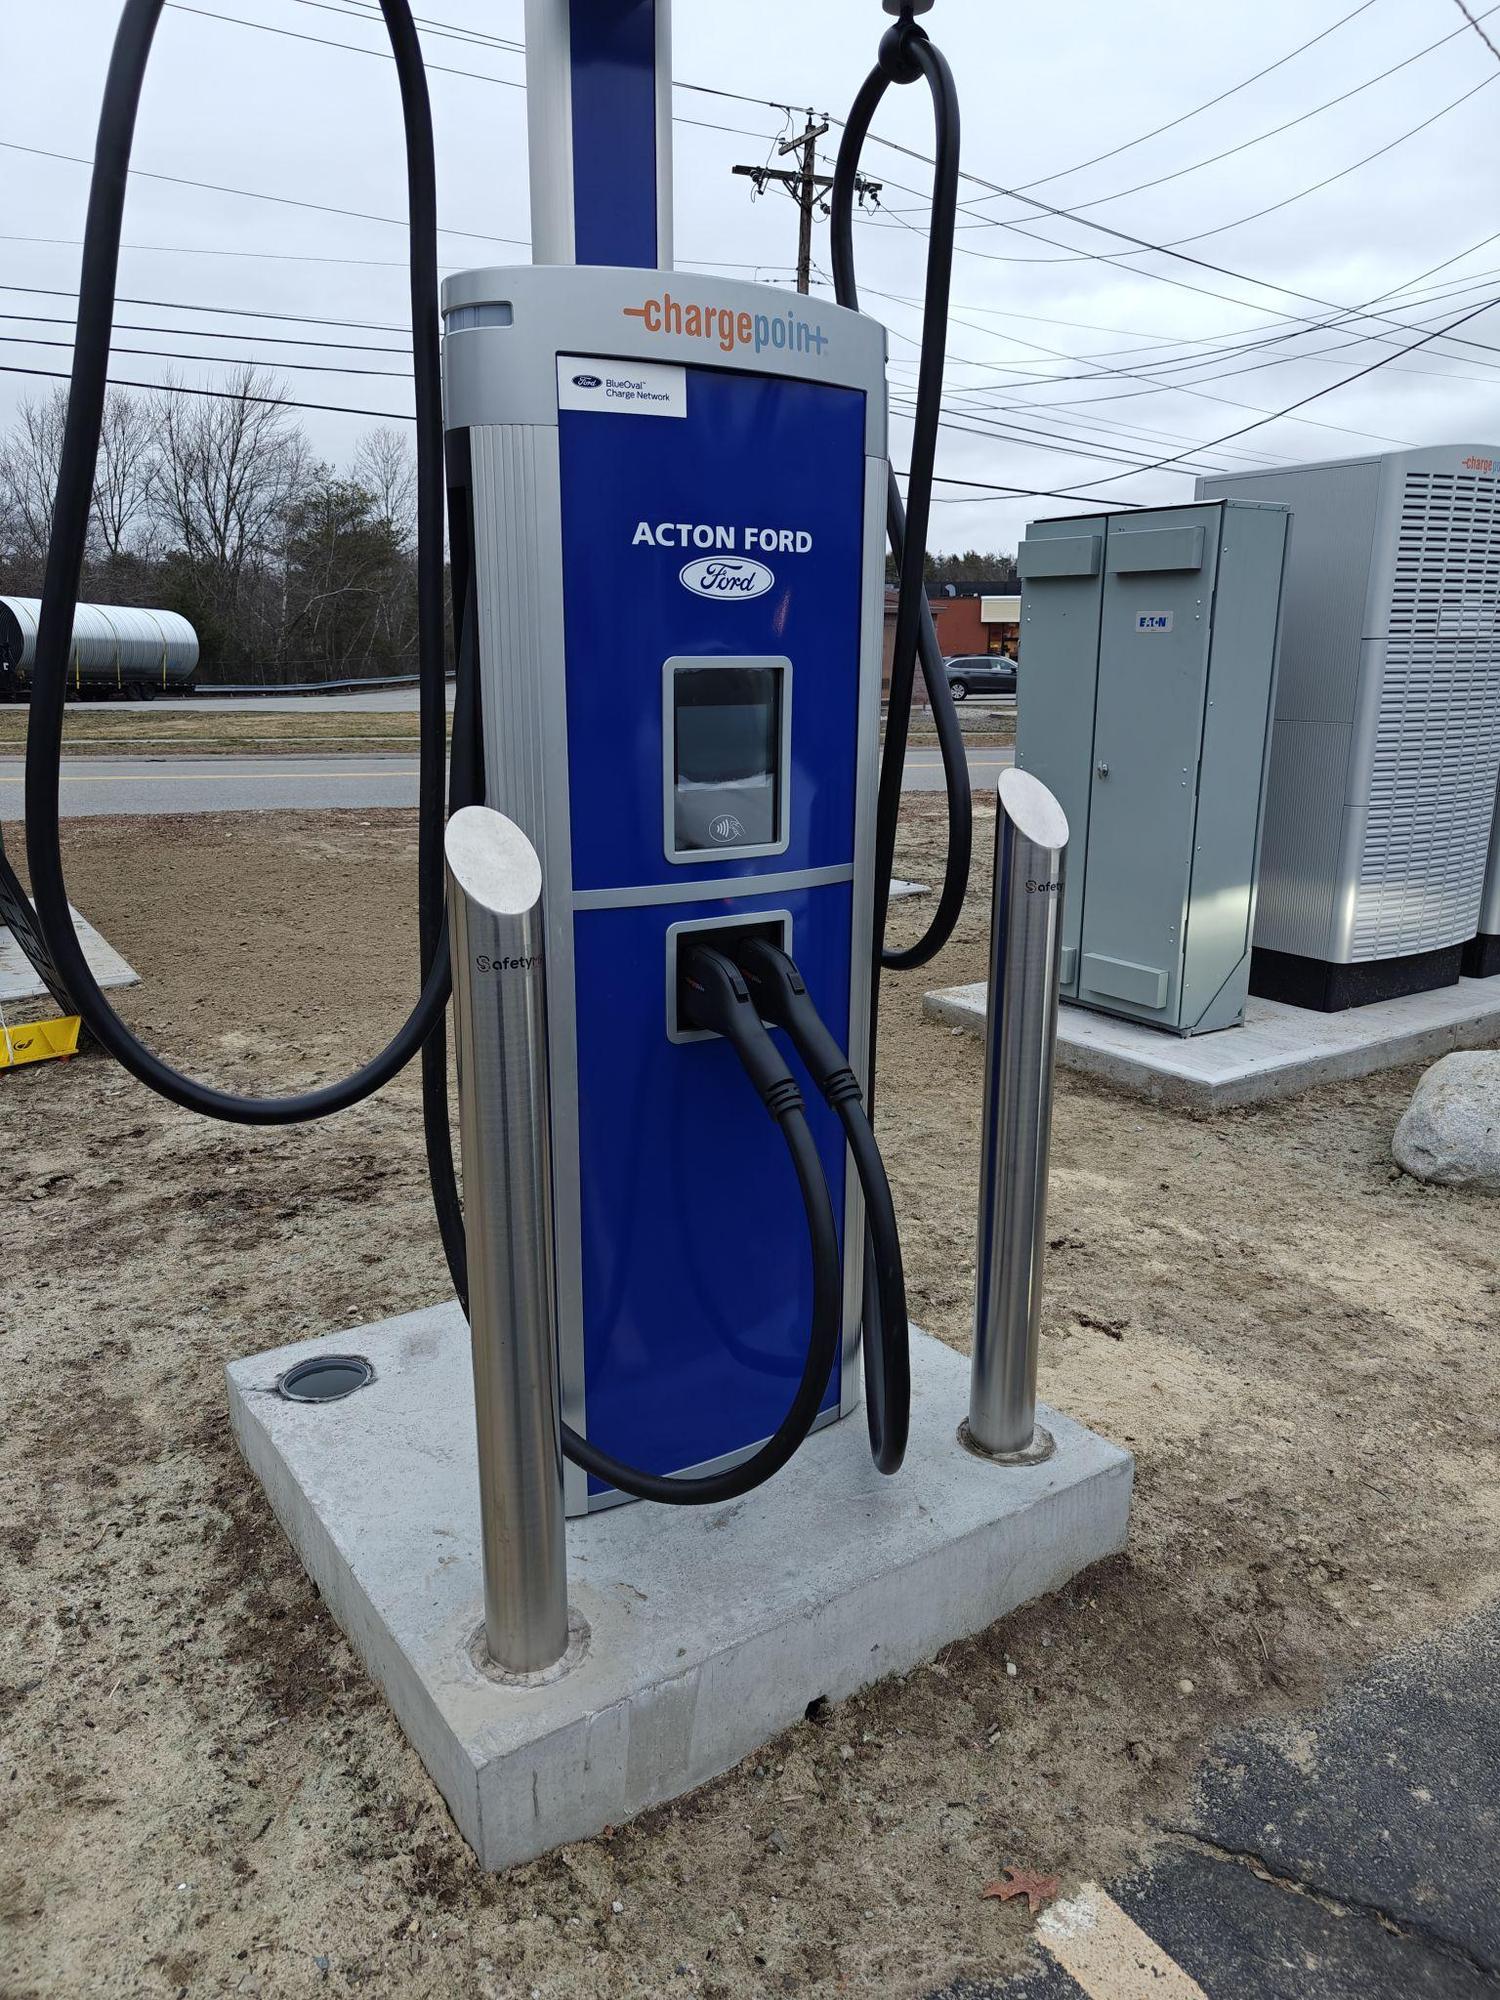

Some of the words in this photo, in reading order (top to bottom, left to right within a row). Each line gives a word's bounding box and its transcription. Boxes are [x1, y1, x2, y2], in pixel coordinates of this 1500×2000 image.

[624, 293, 829, 355] chargepoint
[577, 376, 597, 388] Ford
[605, 388, 636, 400] Charge
[636, 390, 670, 401] Network
[631, 521, 735, 549] ACTON
[744, 527, 813, 554] FORD
[700, 562, 757, 592] Ford
